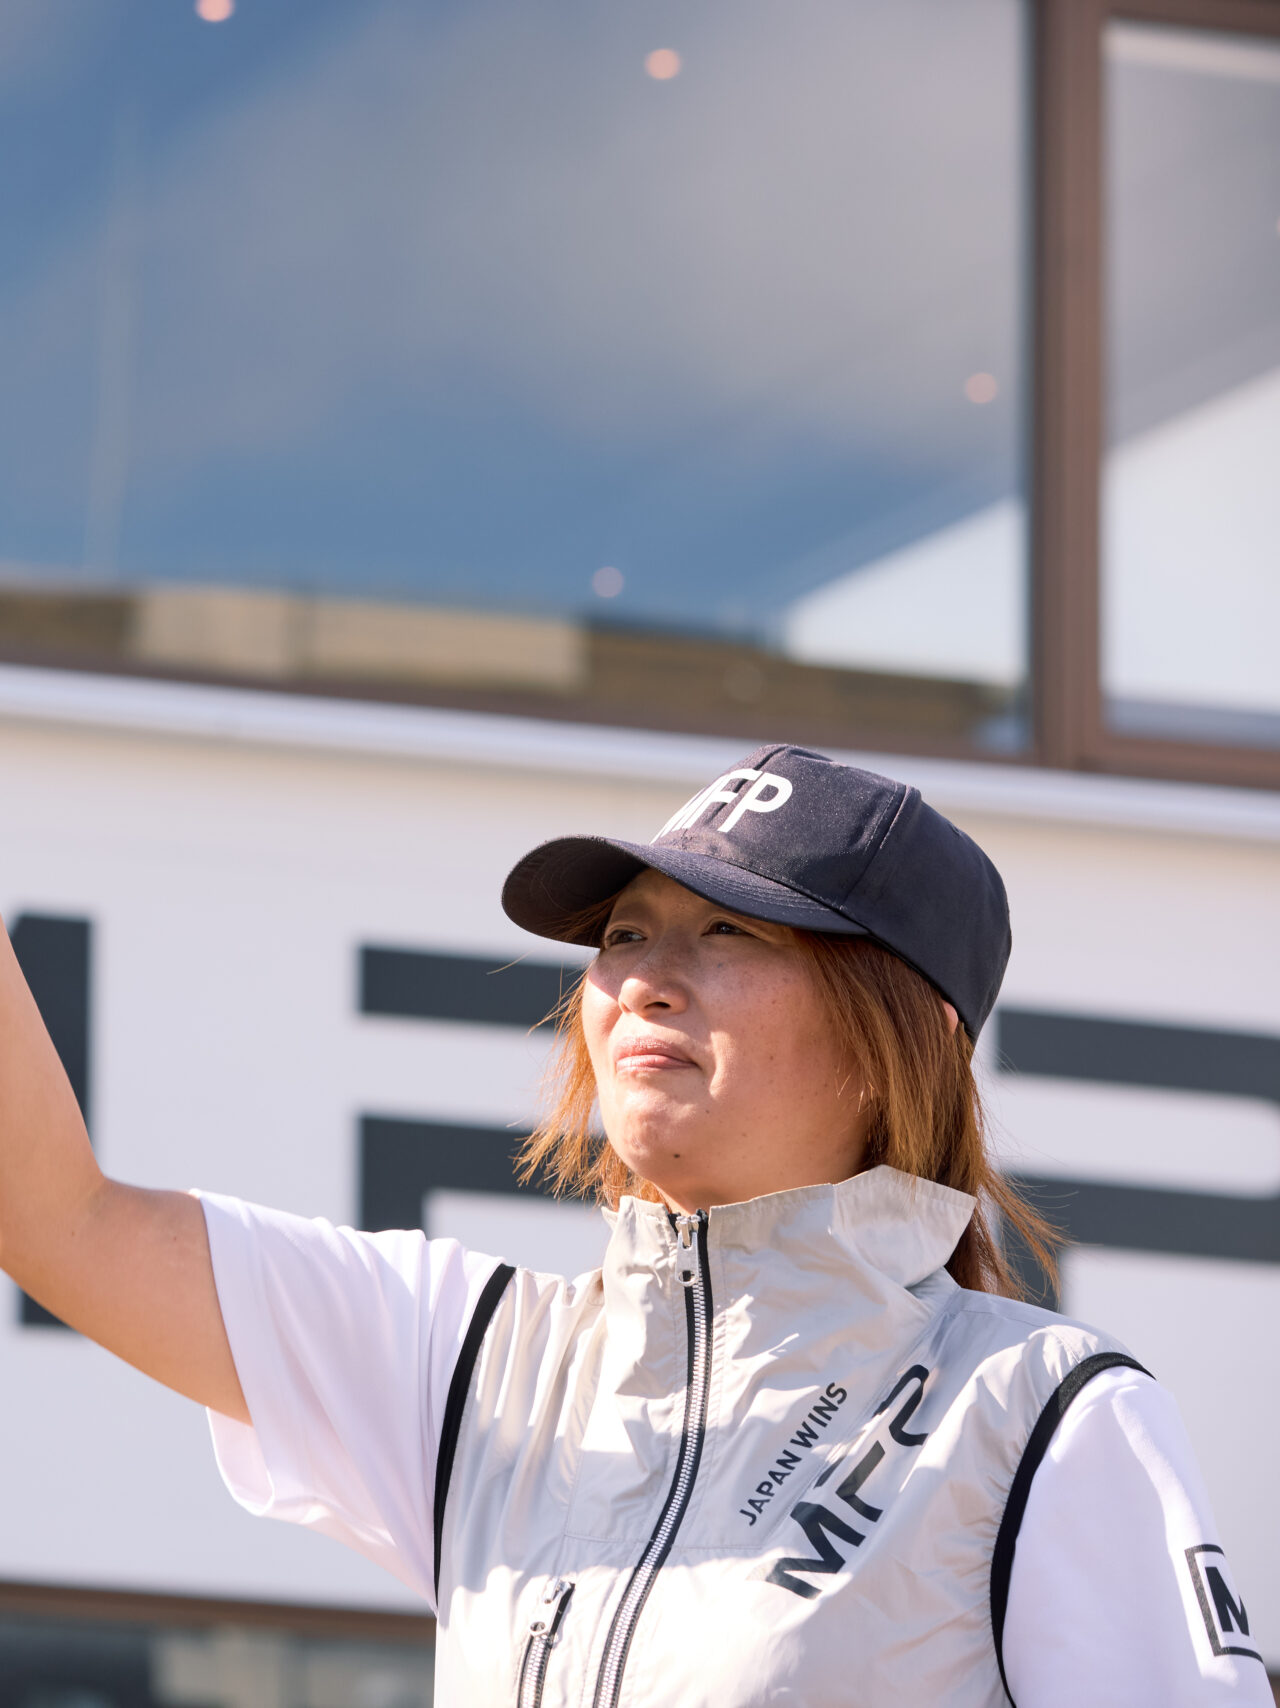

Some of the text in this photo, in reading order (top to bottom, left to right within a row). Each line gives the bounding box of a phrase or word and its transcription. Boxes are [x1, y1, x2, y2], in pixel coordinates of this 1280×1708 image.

[649, 768, 793, 846] MFP
[739, 1382, 848, 1526] JAPAN WINS
[766, 1364, 929, 1600] MFP
